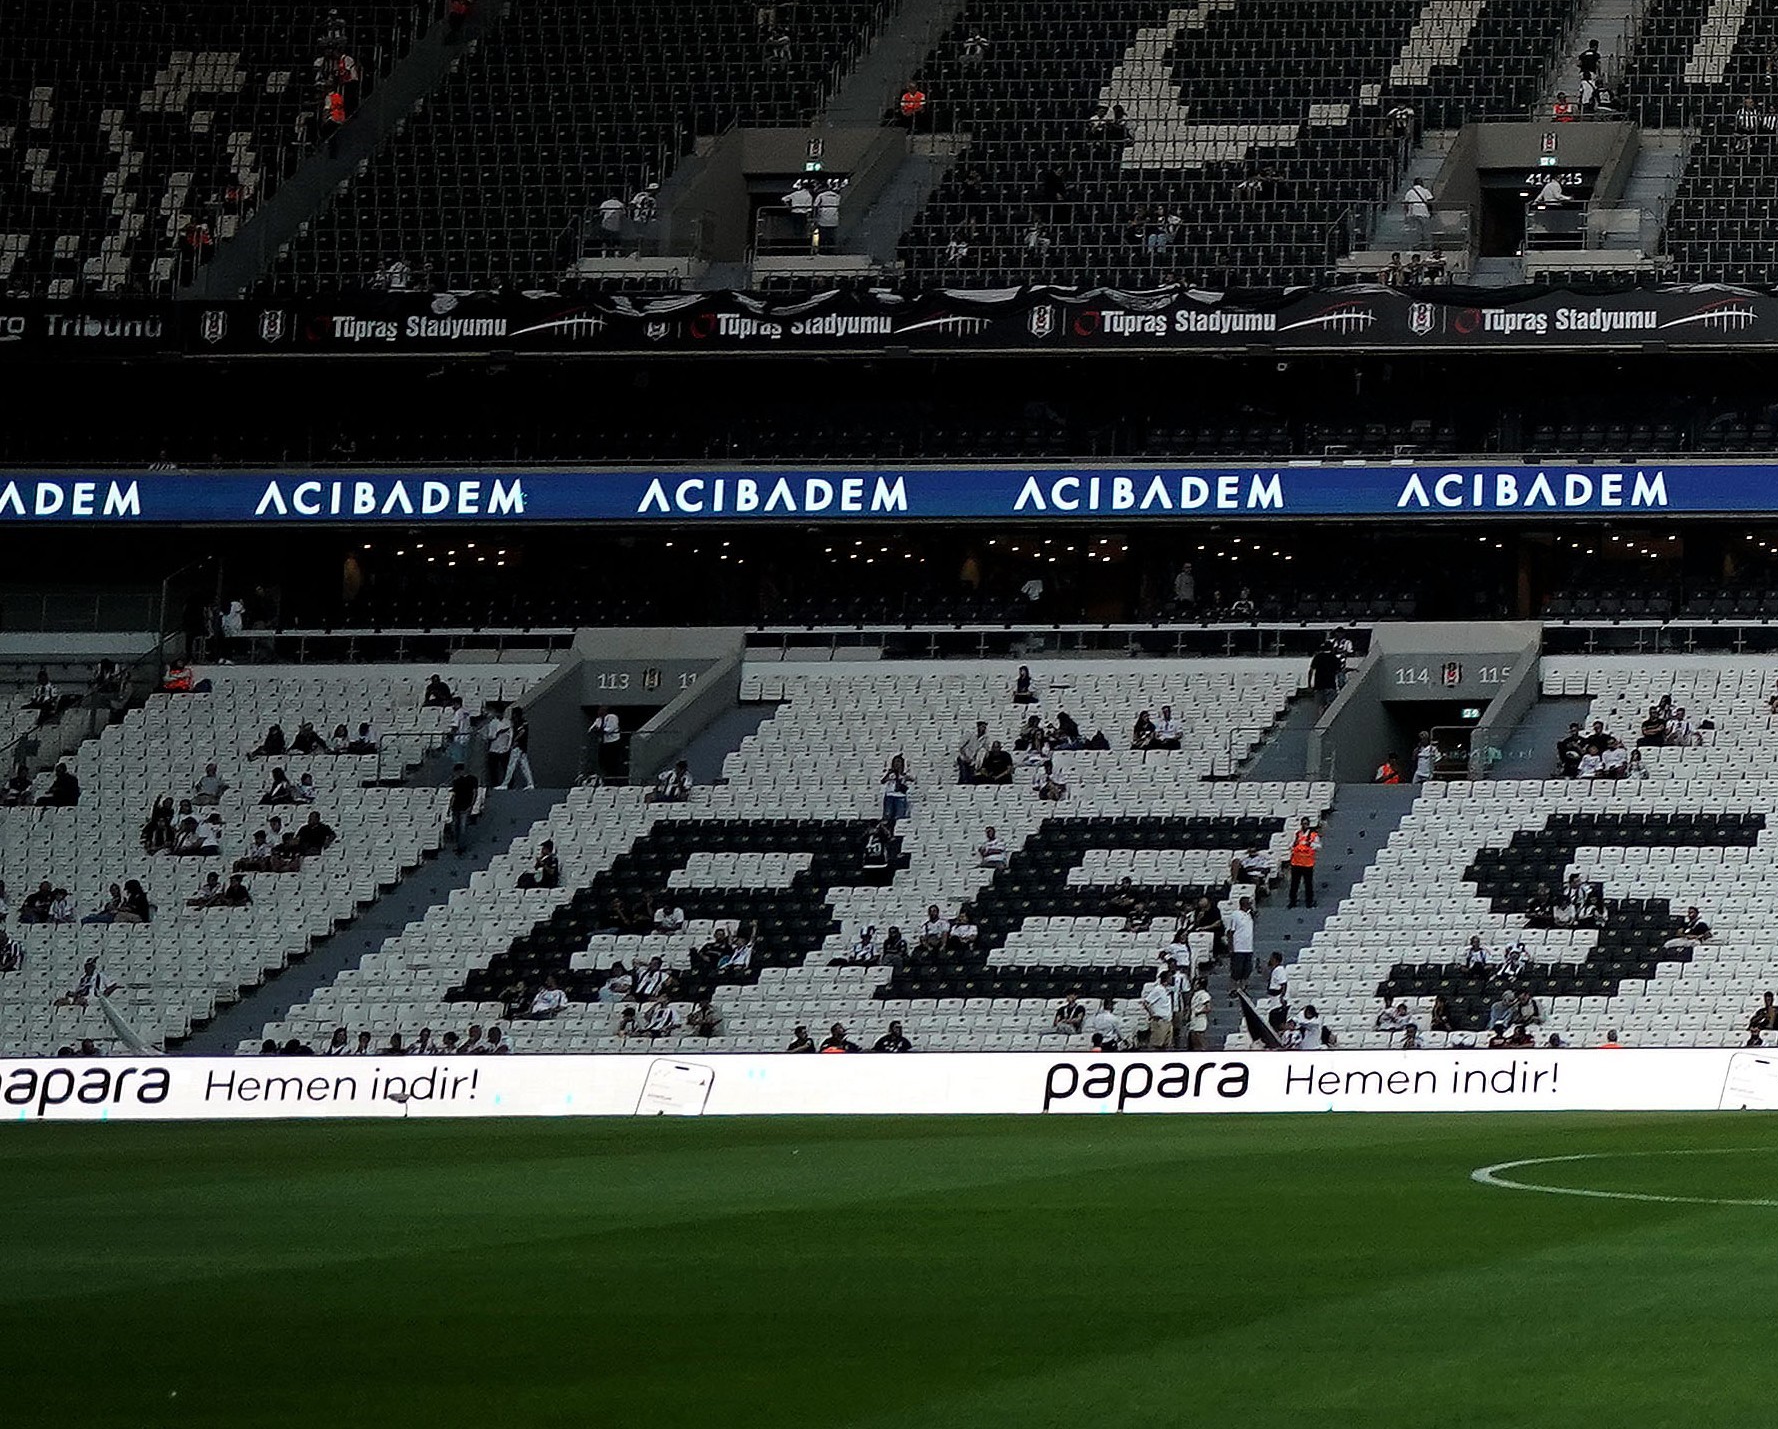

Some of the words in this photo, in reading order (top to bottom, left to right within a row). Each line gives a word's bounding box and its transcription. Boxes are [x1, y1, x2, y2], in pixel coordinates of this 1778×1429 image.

[43, 314, 162, 337] Tribünü
[332, 315, 398, 342] Tüpraş
[406, 315, 507, 339] Stadyumu
[1100, 310, 1167, 335] Tüpraş
[1174, 310, 1277, 334] Stadyumu
[1482, 308, 1548, 334] Tüpraş
[1555, 307, 1657, 332] Stadyumu
[256, 479, 523, 514] ACIBADEM
[638, 477, 907, 512] ACIBADEM
[1014, 474, 1283, 510] ACIBADEM
[1398, 471, 1667, 506] ACIBADEM
[597, 673, 629, 690] 113
[678, 673, 698, 690] 11
[1396, 668, 1430, 685] 114
[0, 1067, 170, 1117] apara
[205, 1068, 357, 1102] Hemen
[371, 1065, 479, 1101] indir!
[1043, 1061, 1250, 1112] papara
[1285, 1064, 1437, 1095] Hemen
[1451, 1060, 1558, 1094] indir!
